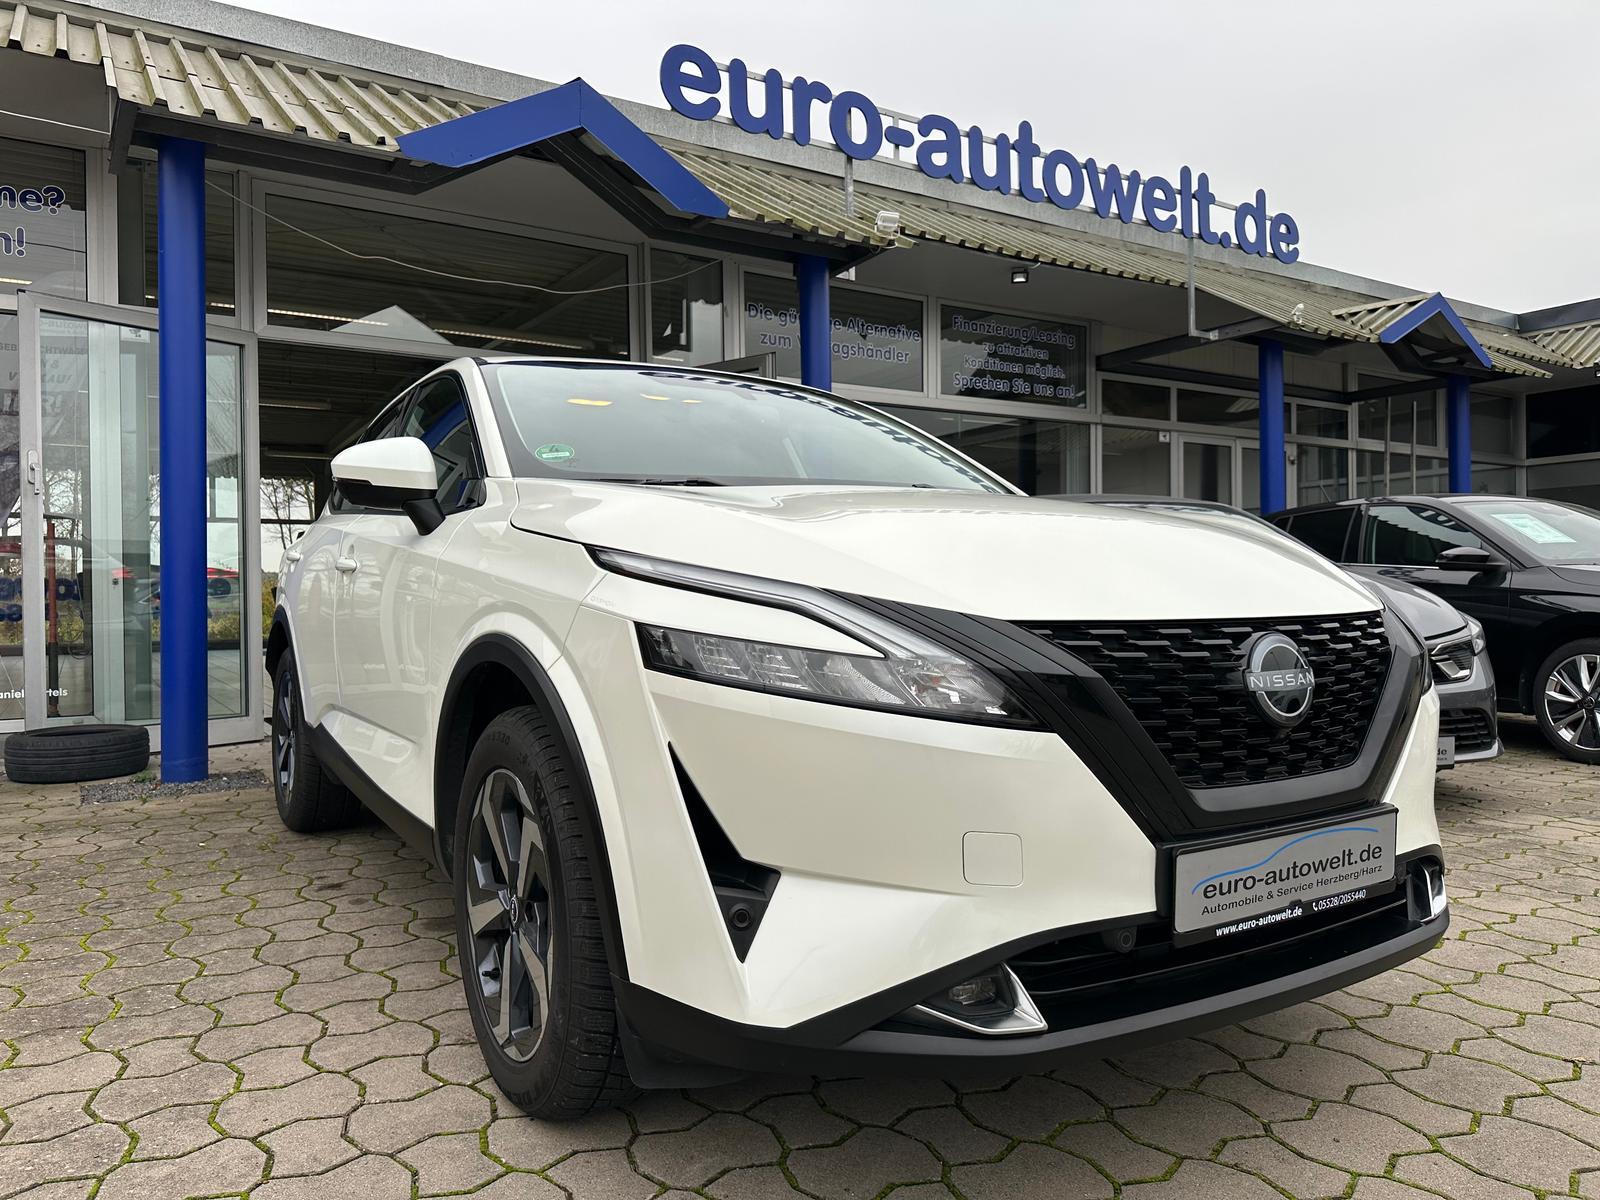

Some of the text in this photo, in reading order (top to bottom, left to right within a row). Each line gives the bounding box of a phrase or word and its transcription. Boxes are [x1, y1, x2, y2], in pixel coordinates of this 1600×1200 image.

[660, 43, 1300, 264] euro-autowelt.de
[748, 303, 773, 320] Die
[847, 318, 921, 342] Alternative
[952, 315, 1076, 349] Finanzierung/Leasing
[760, 333, 792, 349] zum
[983, 342, 1049, 360] zu attraktiven
[963, 355, 1066, 380] Konditionen möglich.
[953, 372, 1076, 399] Sprechen Sie uns an!
[1249, 672, 1314, 688] NISSAN
[1203, 844, 1383, 899] euro-autowelt.de
[1201, 863, 1383, 916] Automobile & Service Herzberg/Harz
[1215, 888, 1367, 937] www.euro-autowelt.de 05528/2055440
